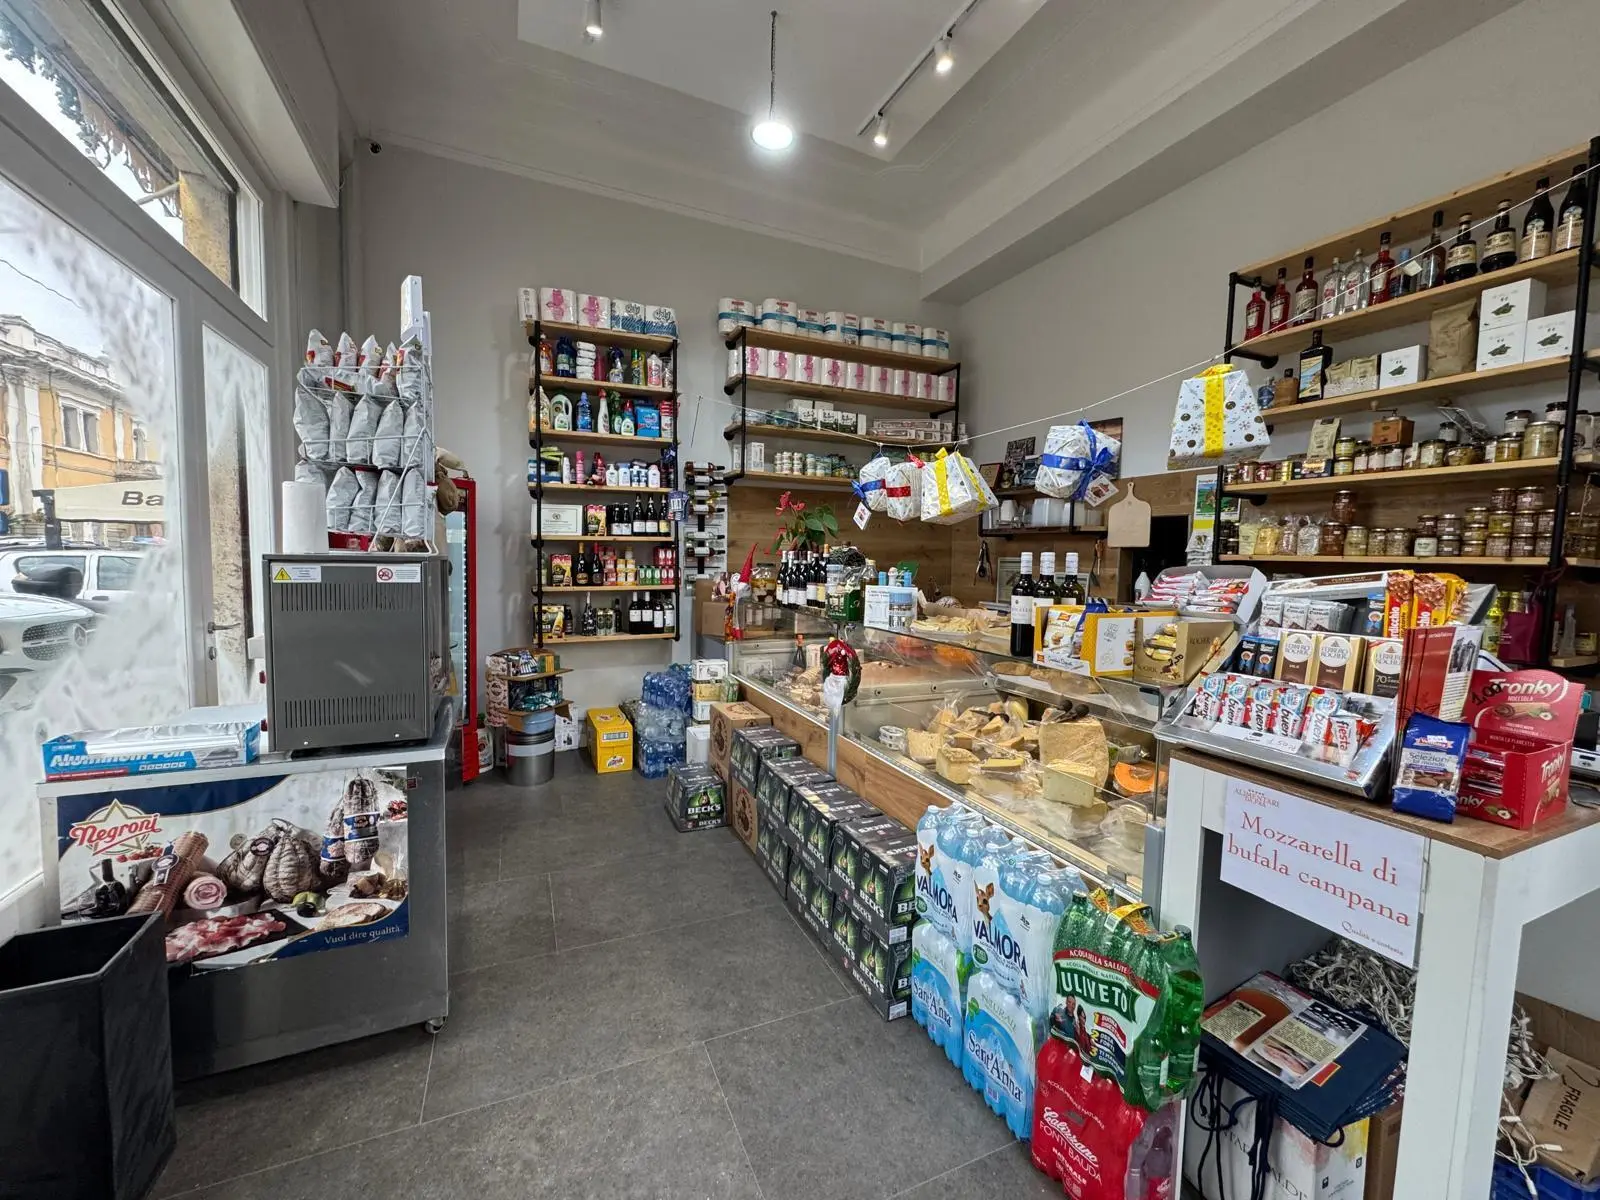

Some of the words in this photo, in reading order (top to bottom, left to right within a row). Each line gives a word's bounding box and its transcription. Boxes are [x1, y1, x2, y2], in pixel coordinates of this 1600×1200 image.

[121, 490, 164, 506] Ba
[1489, 678, 1560, 698] Tronky
[1227, 698, 1239, 725] buen
[1255, 703, 1267, 731] buen
[1281, 708, 1293, 736] buen
[1336, 720, 1350, 751] fiesta
[688, 804, 720, 814] BECK'S
[1456, 795, 1484, 807] onky
[69, 814, 162, 847] Negroni
[1240, 811, 1363, 873] Mozzarella
[1373, 857, 1399, 886] di
[833, 864, 855, 890] BECK'S
[1227, 833, 1290, 876] bufala
[1298, 871, 1411, 927] campana
[860, 888, 884, 918] BECK'S
[916, 875, 958, 924] VALMORA
[324, 932, 347, 944] Vuol
[349, 931, 367, 940] dire
[973, 919, 1029, 978] VALMORA
[860, 960, 884, 994] BECK'S
[1104, 959, 1129, 974] SALUTE
[913, 976, 952, 1028] Sant'Anna
[1060, 971, 1128, 1013] ULIVETO
[1091, 1029, 1099, 1040] 2
[1089, 1046, 1098, 1056] 3
[968, 1031, 1022, 1103] Sant'Anna
[1553, 1085, 1581, 1130] FRAGILE
[1040, 1120, 1067, 1149] FONTI
[1068, 1149, 1103, 1186] BAUDA
